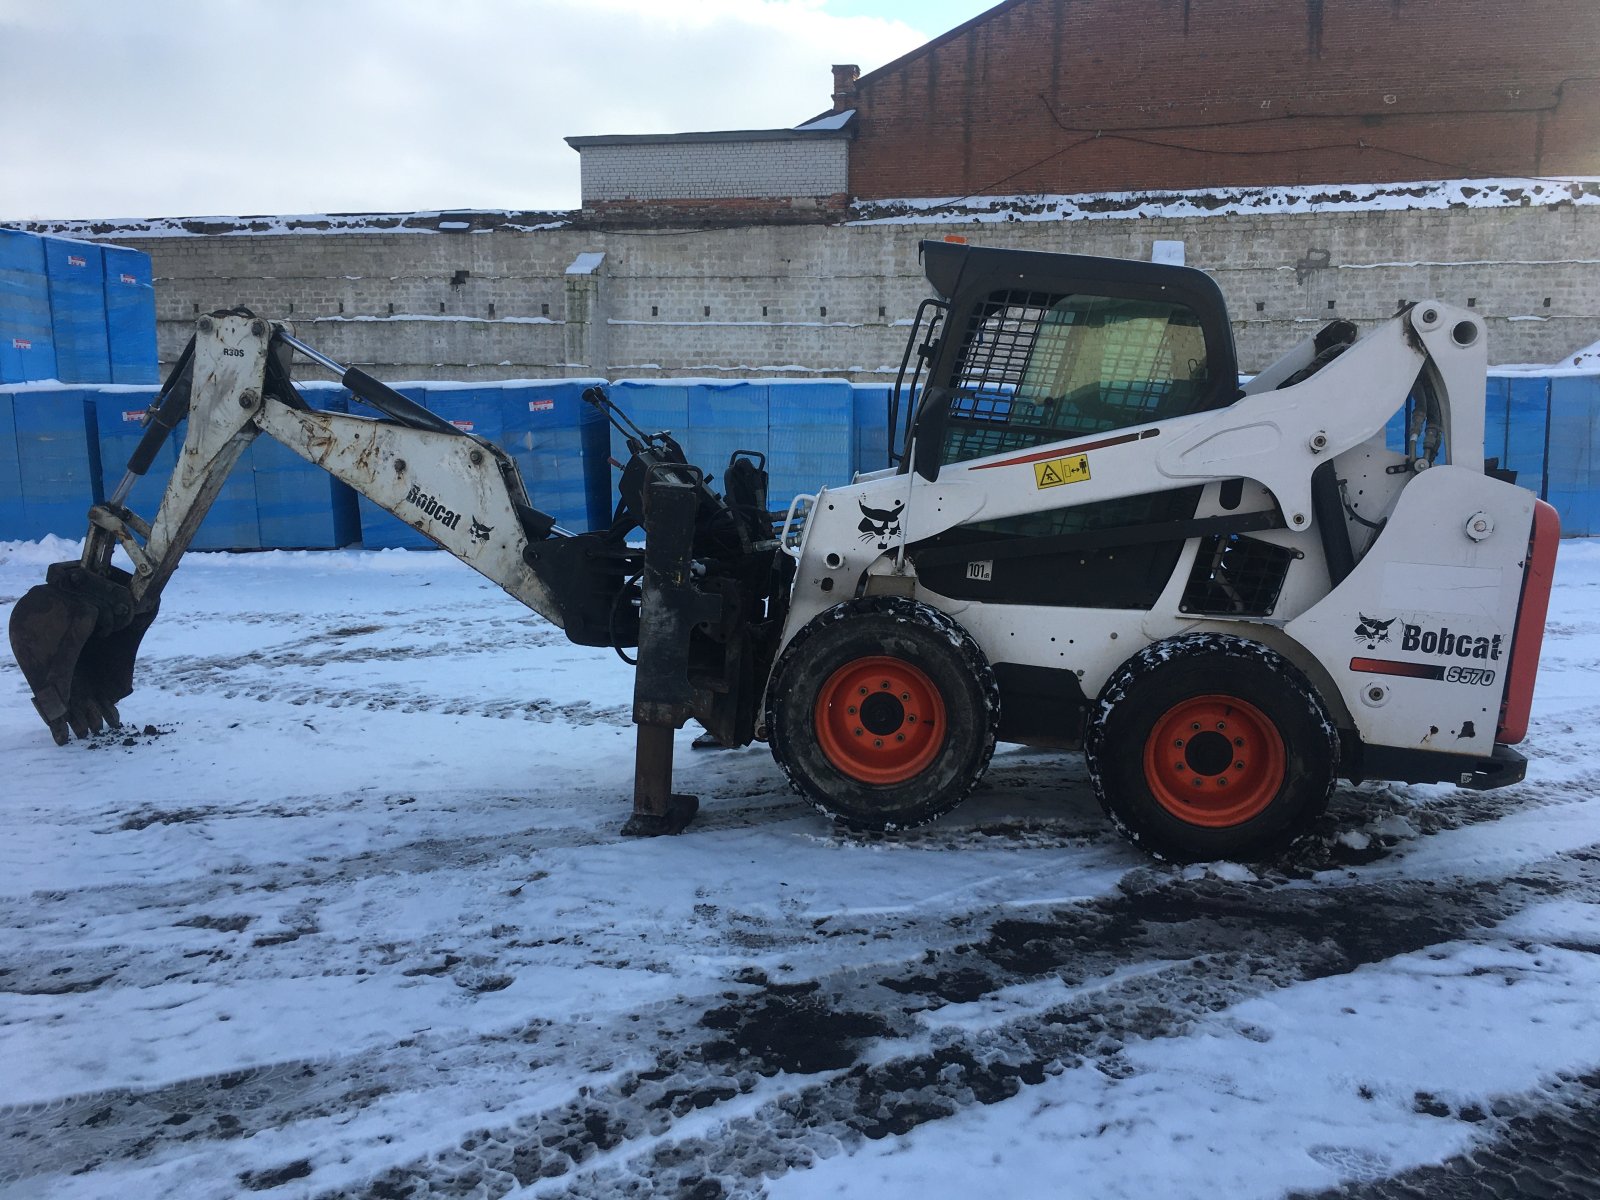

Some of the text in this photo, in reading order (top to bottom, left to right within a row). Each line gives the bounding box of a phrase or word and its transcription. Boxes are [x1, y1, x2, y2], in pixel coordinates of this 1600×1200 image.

[405, 484, 461, 531] Bobcat
[969, 563, 985, 578] 101
[1401, 624, 1503, 661] Bobcat
[1446, 666, 1496, 686] S570
